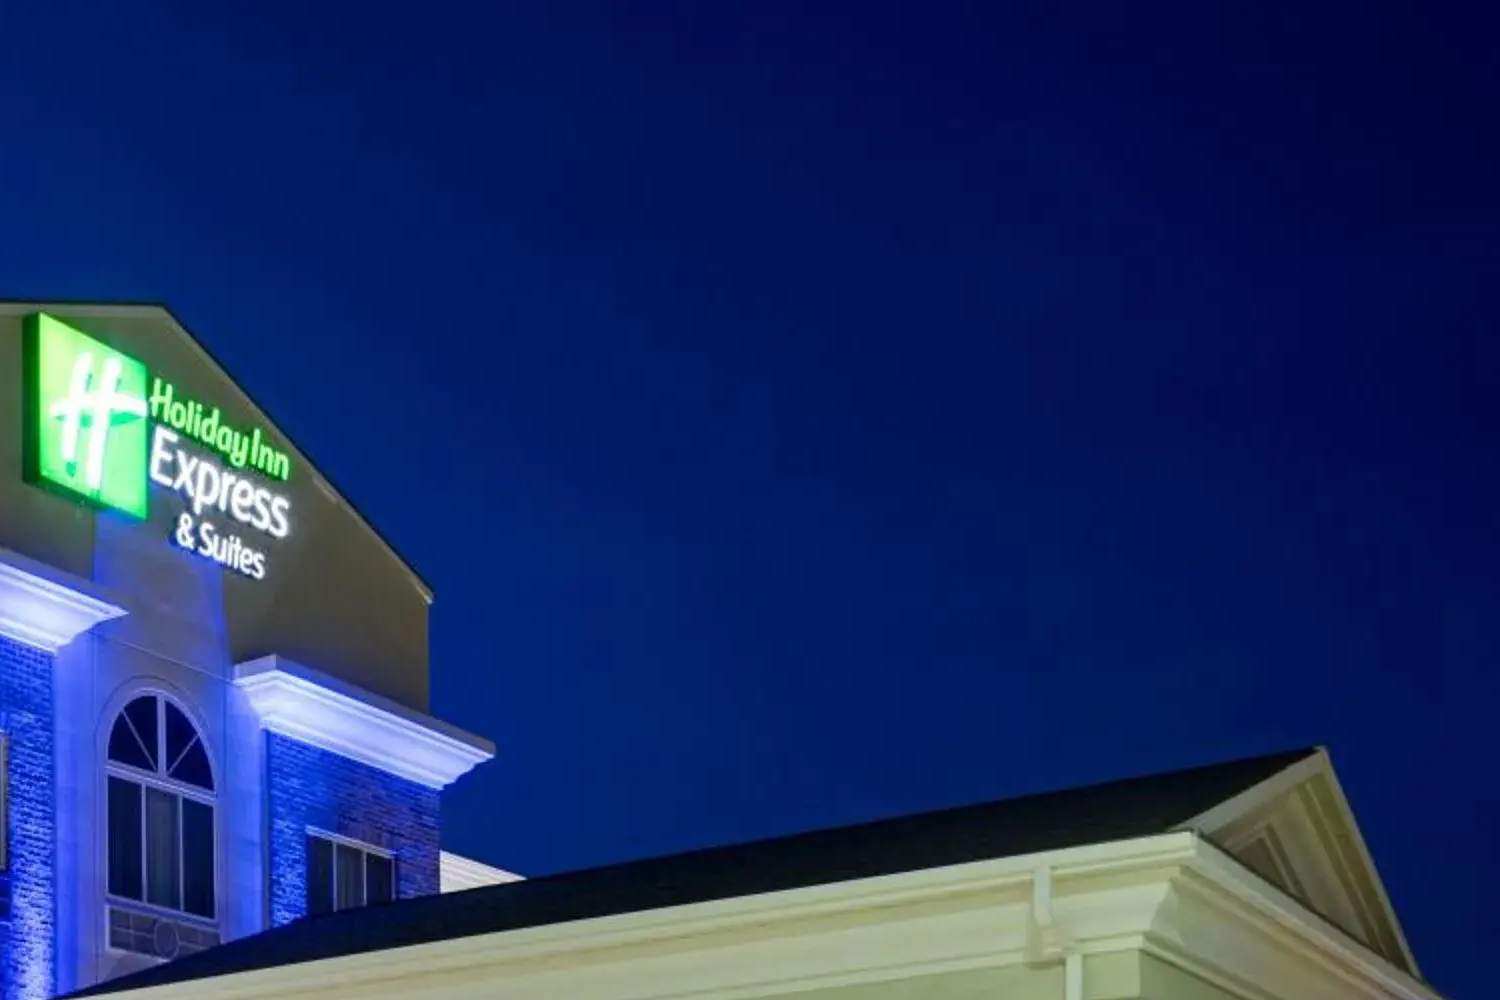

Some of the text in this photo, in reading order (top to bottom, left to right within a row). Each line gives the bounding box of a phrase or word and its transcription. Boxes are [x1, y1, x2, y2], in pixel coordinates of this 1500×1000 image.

[150, 378, 289, 481] Holiday Inn
[150, 424, 290, 538] Express
[176, 512, 266, 580] & Suites
